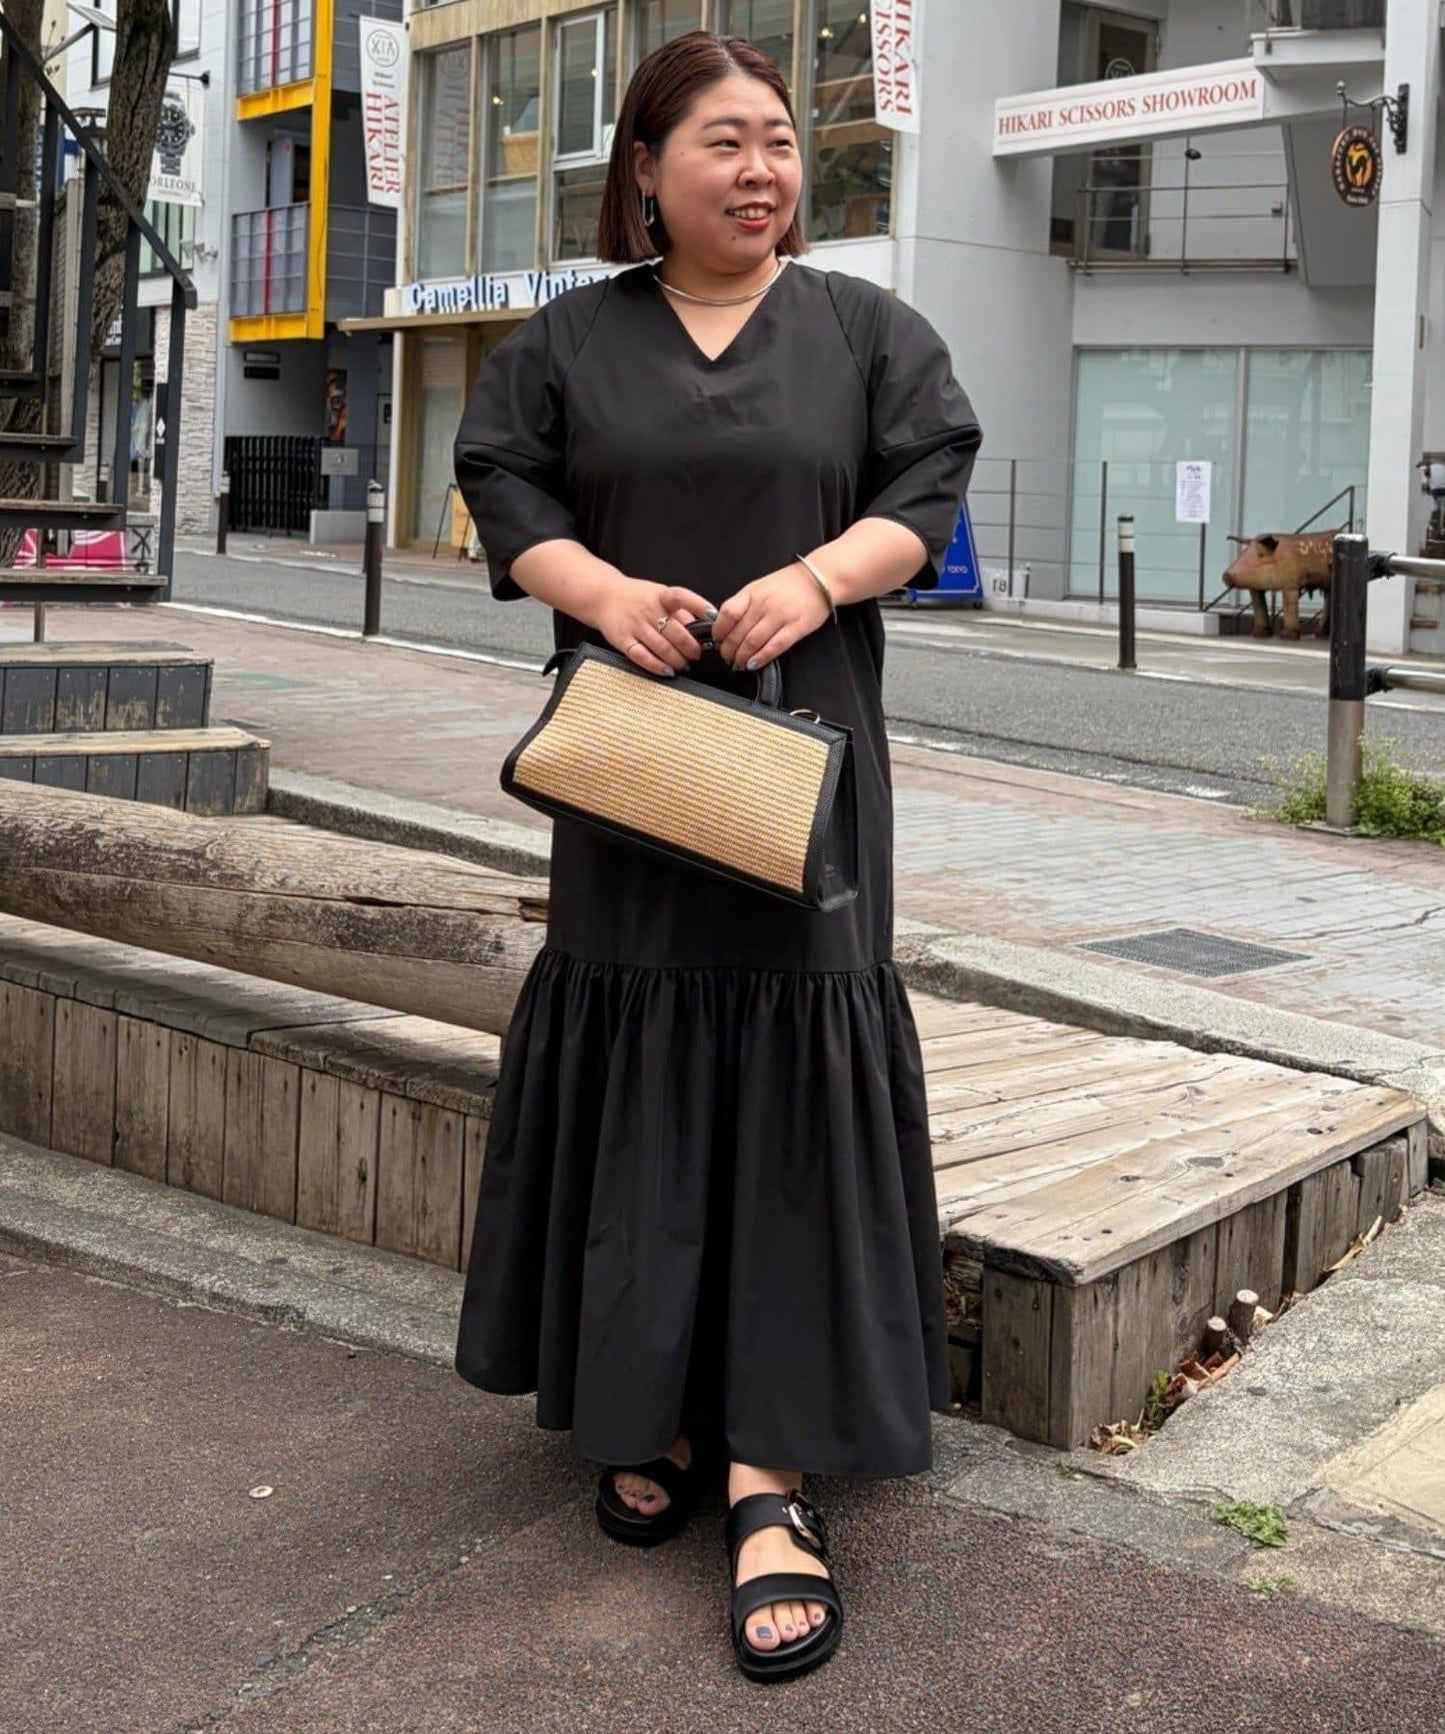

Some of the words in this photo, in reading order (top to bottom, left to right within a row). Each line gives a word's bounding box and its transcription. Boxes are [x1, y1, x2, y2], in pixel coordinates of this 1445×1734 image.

[894, 0, 912, 115] IKARI
[366, 93, 384, 191] HIKARI
[383, 95, 400, 194] ATELIER
[998, 110, 1053, 136] HIKARI
[1058, 97, 1136, 127] SCISSORS
[1141, 80, 1257, 115] SHOWROOM
[411, 276, 508, 312] Camellia
[523, 270, 608, 303] Vinta
